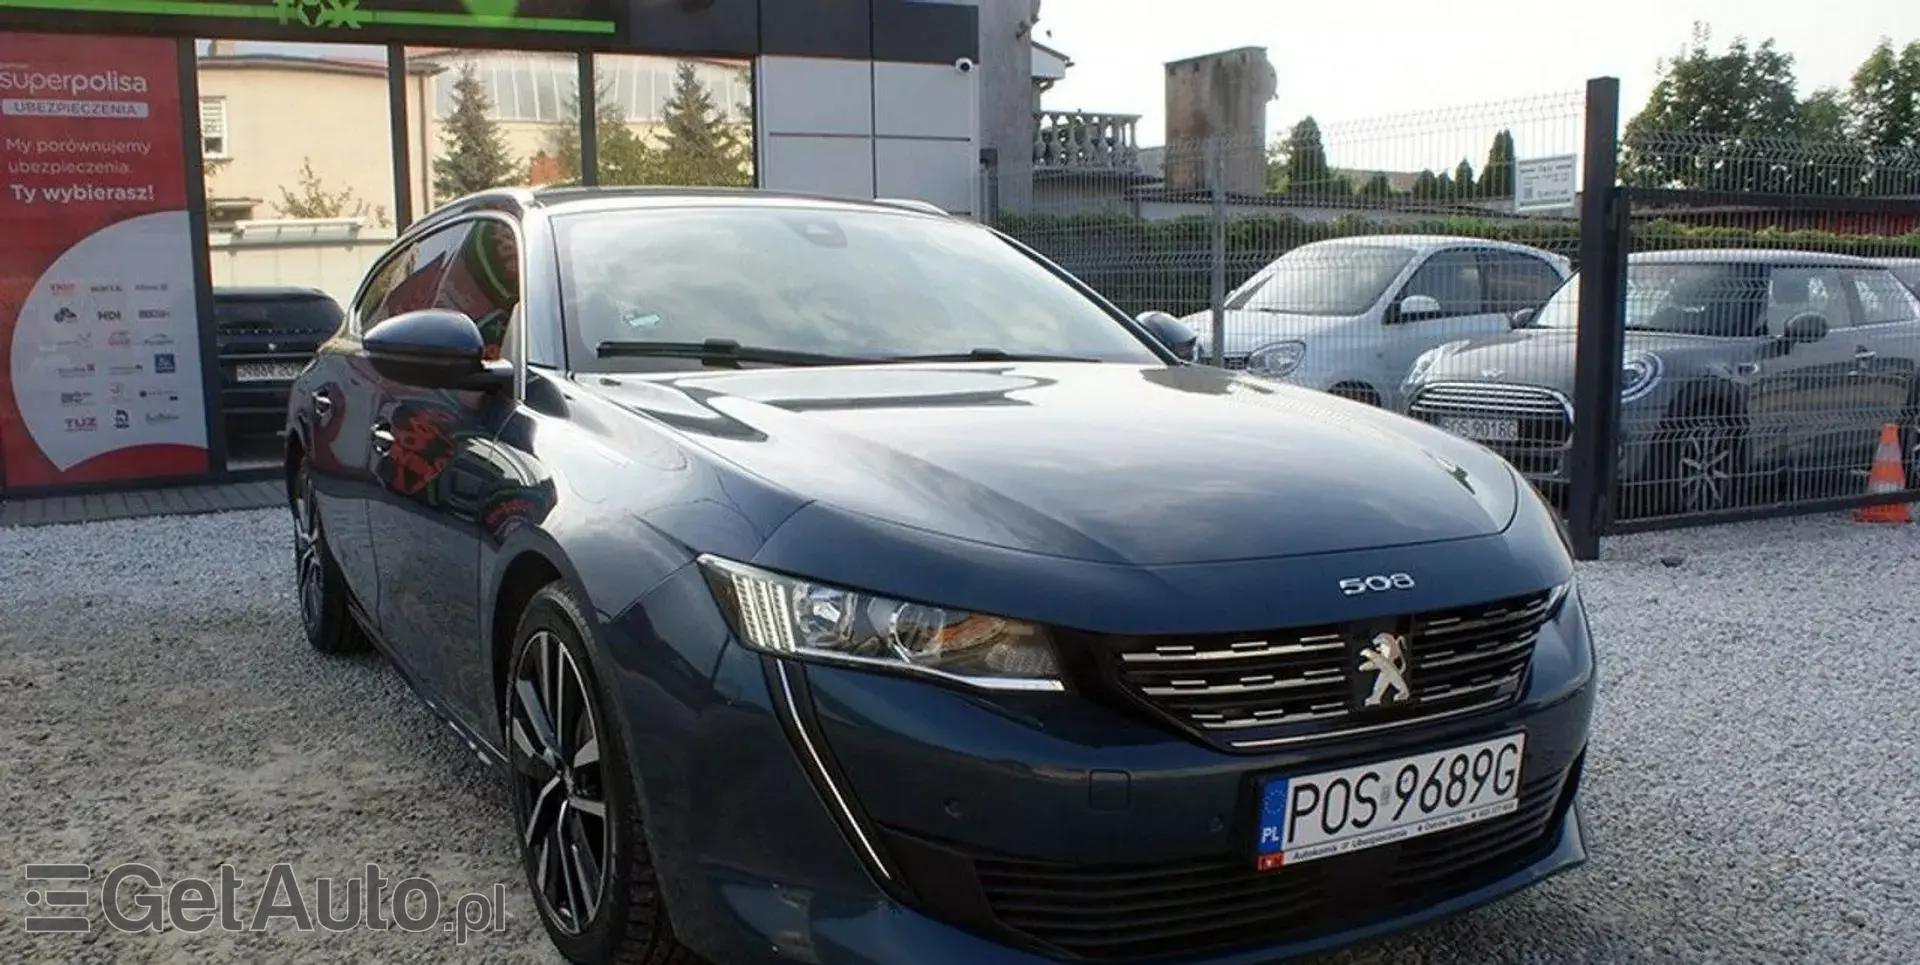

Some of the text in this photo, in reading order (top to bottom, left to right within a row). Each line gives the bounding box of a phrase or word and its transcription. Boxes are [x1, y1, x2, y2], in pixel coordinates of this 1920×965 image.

[0, 70, 148, 95] superpolisa
[14, 101, 138, 115] UBEZPIECZENIA
[6, 138, 151, 155] My porównujemy
[10, 184, 154, 203] Ty wybierasz!
[1339, 572, 1416, 596] 508
[1287, 743, 1518, 843] POS 9689G
[1261, 826, 1280, 843] PL
